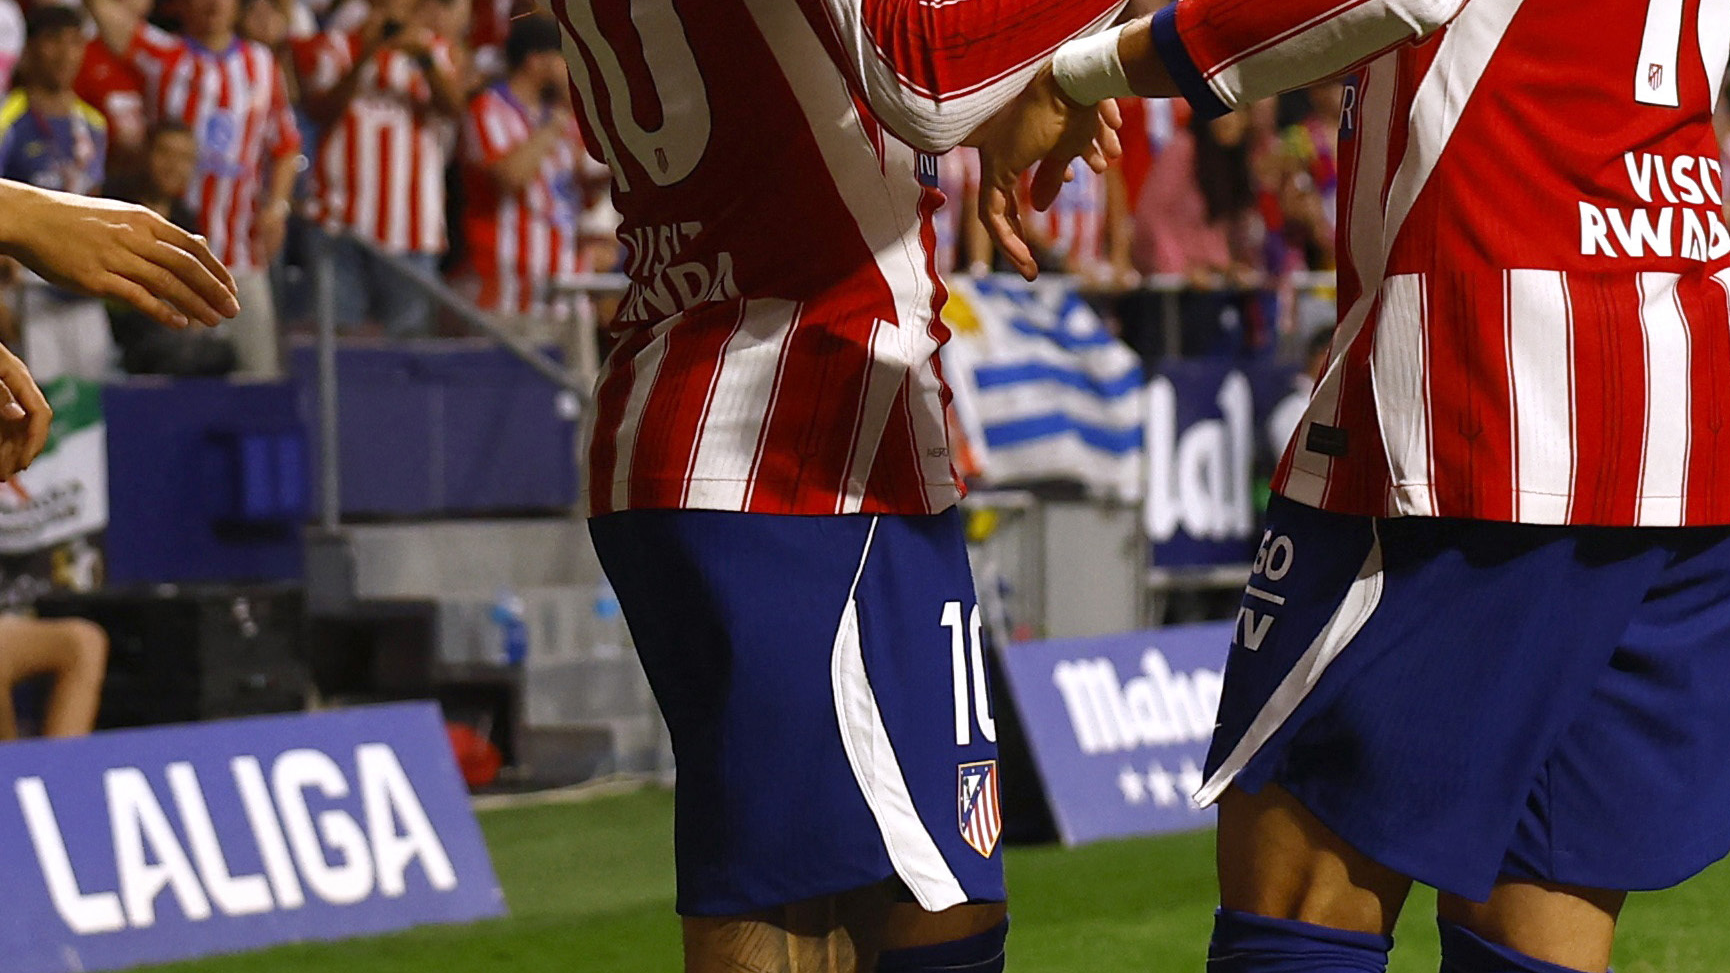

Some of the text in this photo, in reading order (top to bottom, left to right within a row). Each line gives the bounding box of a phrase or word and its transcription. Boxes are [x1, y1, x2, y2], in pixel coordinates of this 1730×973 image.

[1624, 151, 1723, 206] VISI
[1053, 646, 1225, 755] Maho
[14, 742, 458, 935] LALIGA
